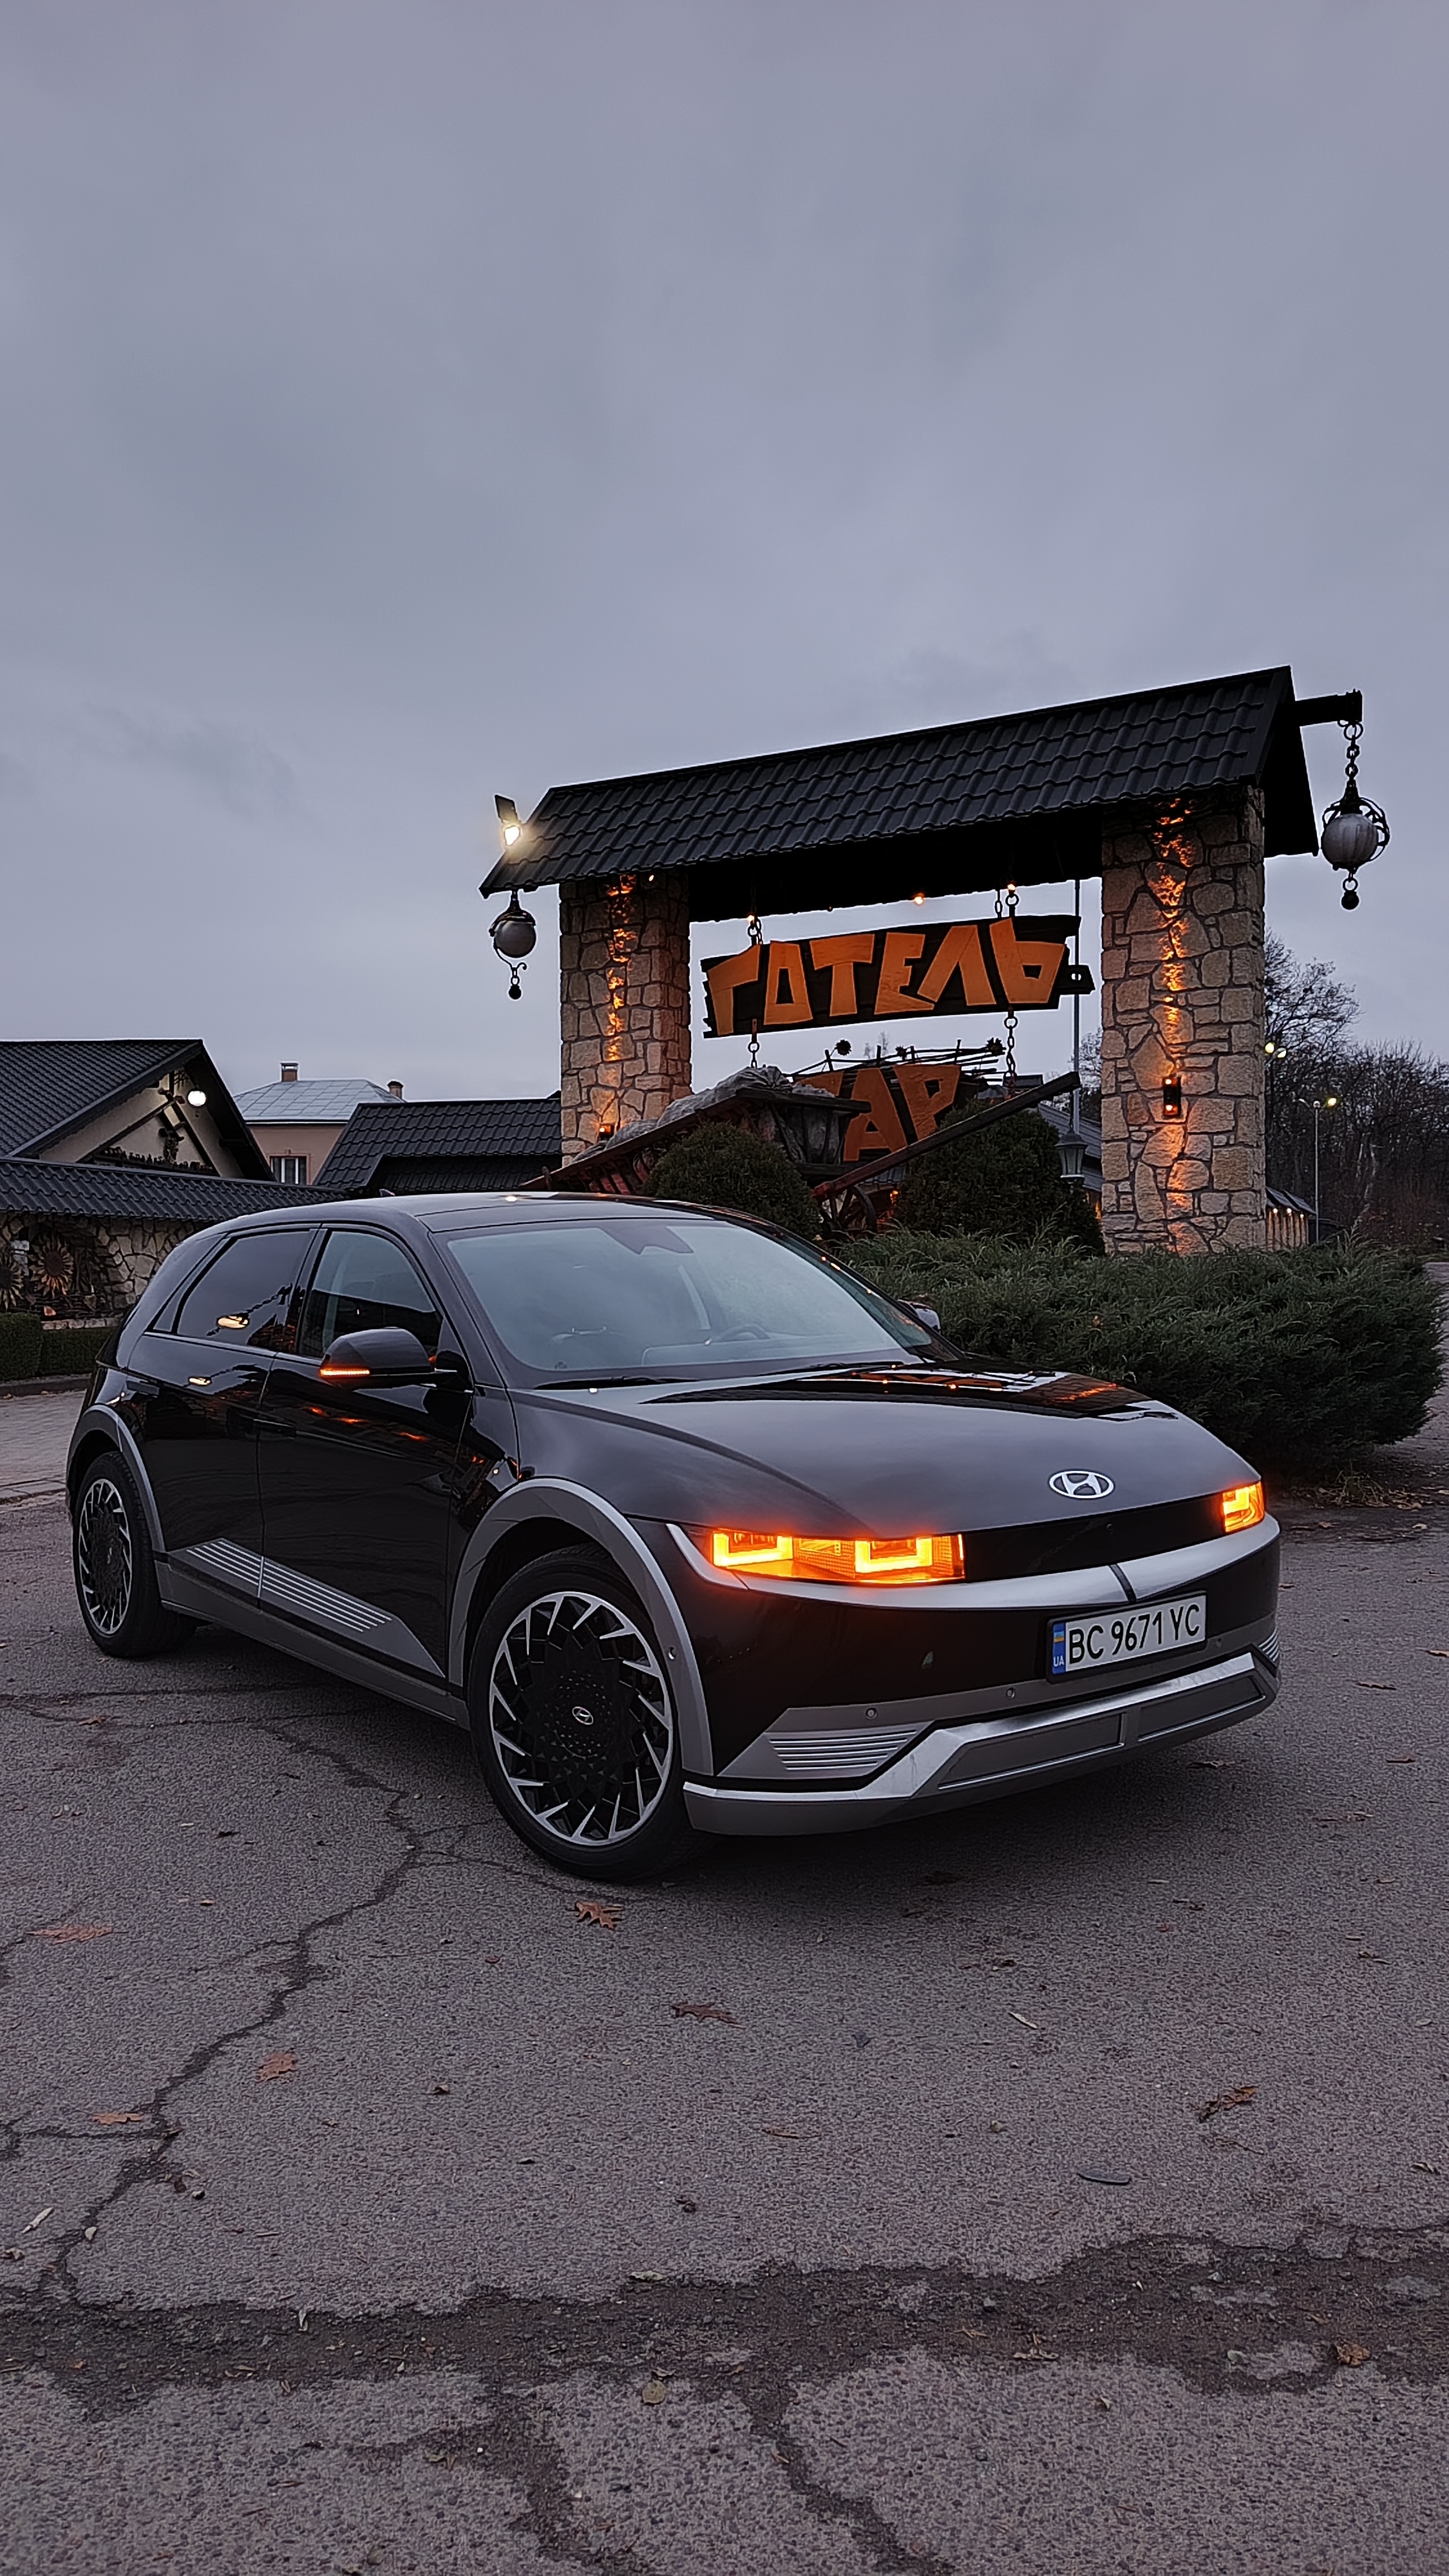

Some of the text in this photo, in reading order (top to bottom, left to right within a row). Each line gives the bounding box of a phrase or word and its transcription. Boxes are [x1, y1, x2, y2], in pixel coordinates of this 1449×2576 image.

[707, 916, 1066, 1036] ГОТЕЛЬ
[1053, 1655, 1065, 1667] UA
[1069, 1604, 1199, 1665] BC 9671 YC
